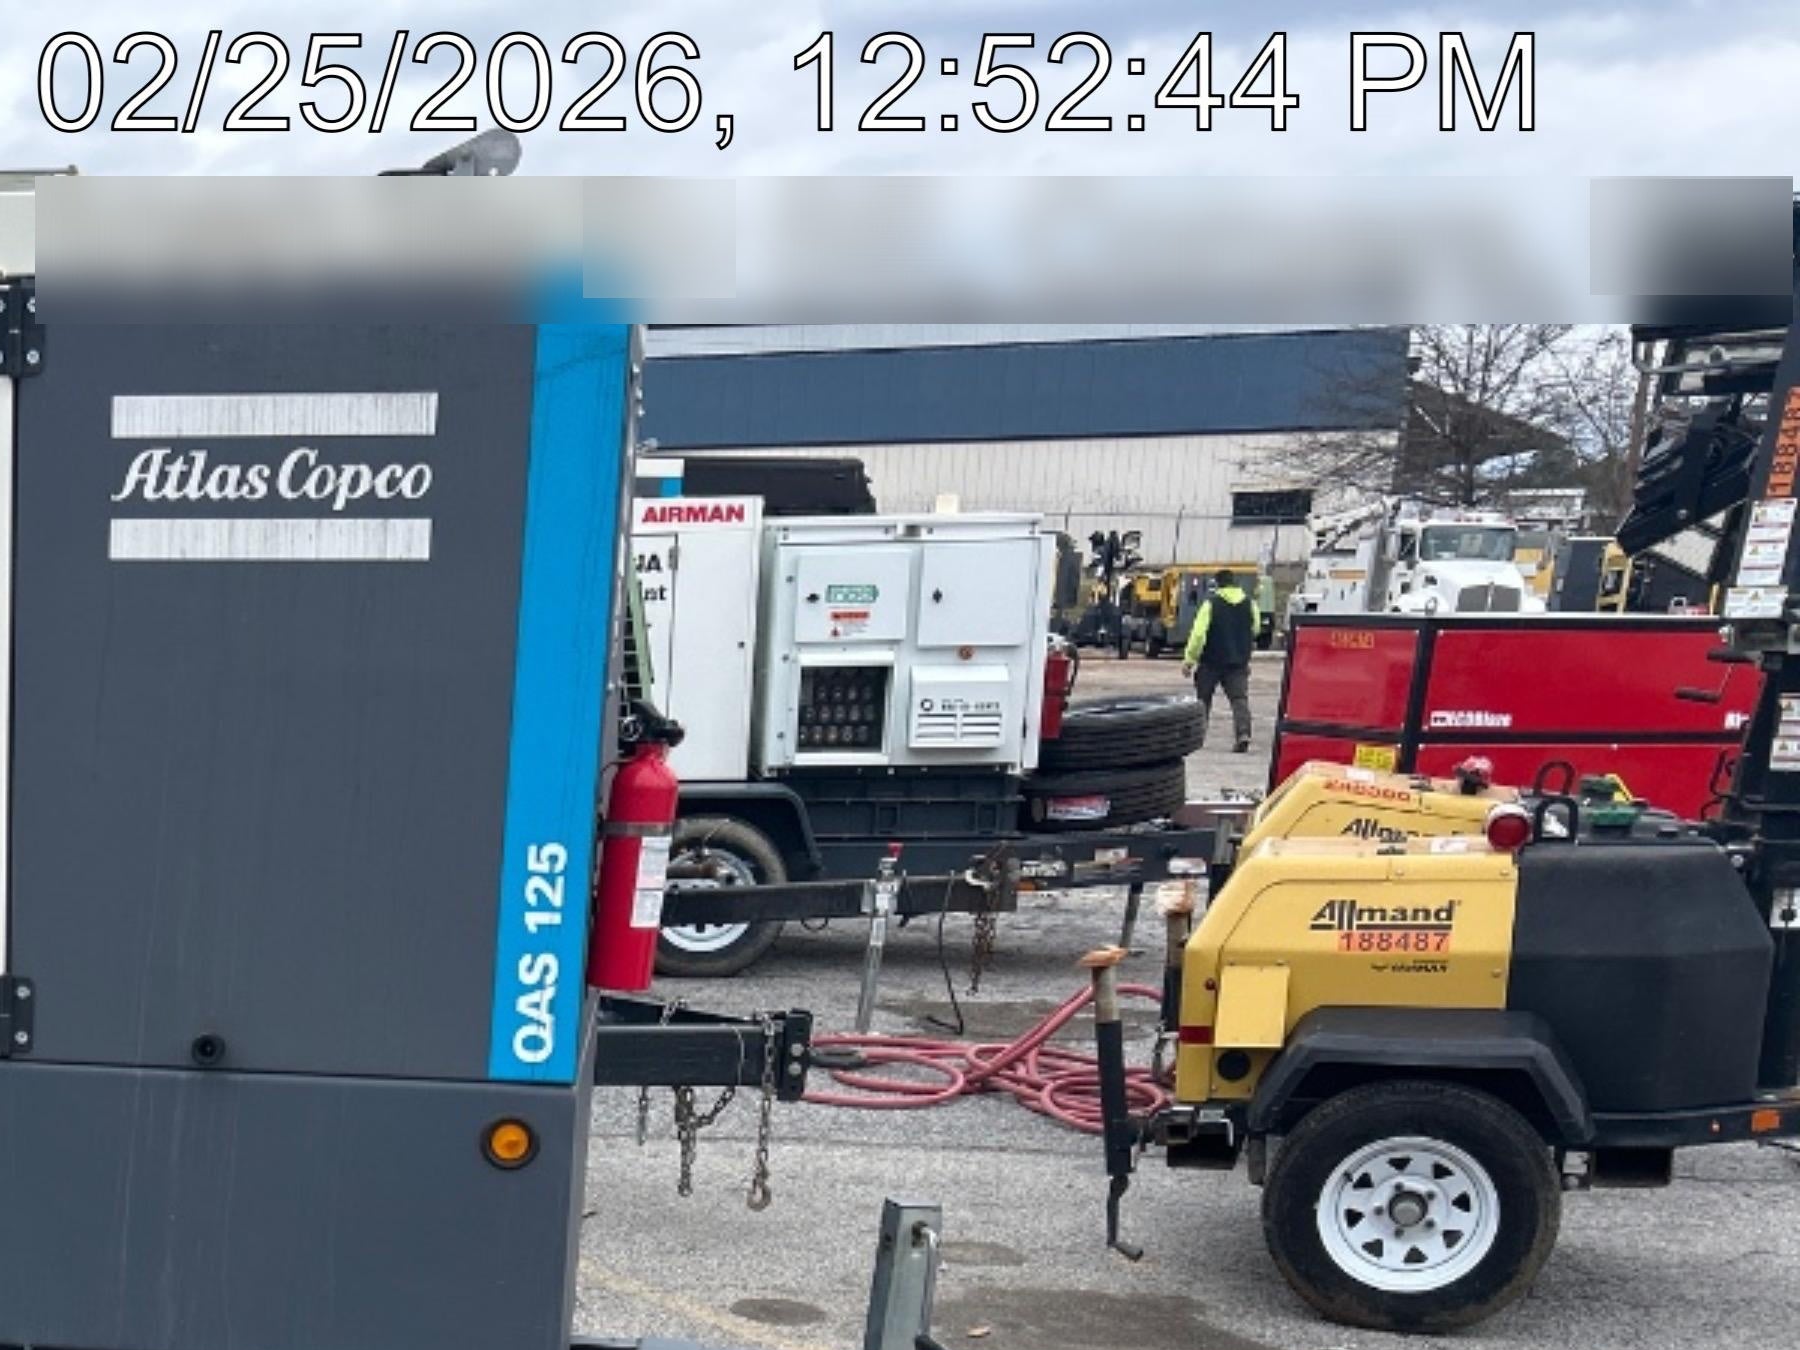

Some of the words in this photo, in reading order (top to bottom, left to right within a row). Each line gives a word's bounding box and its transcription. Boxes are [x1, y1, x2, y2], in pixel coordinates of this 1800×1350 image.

[110, 447, 271, 502] Atlas
[275, 446, 433, 511] Copco
[642, 504, 746, 524] AIRMAN
[522, 841, 570, 935] 125
[1309, 899, 1454, 931] Allmand
[1340, 932, 1450, 953] 188487
[511, 952, 561, 1065] QAS
